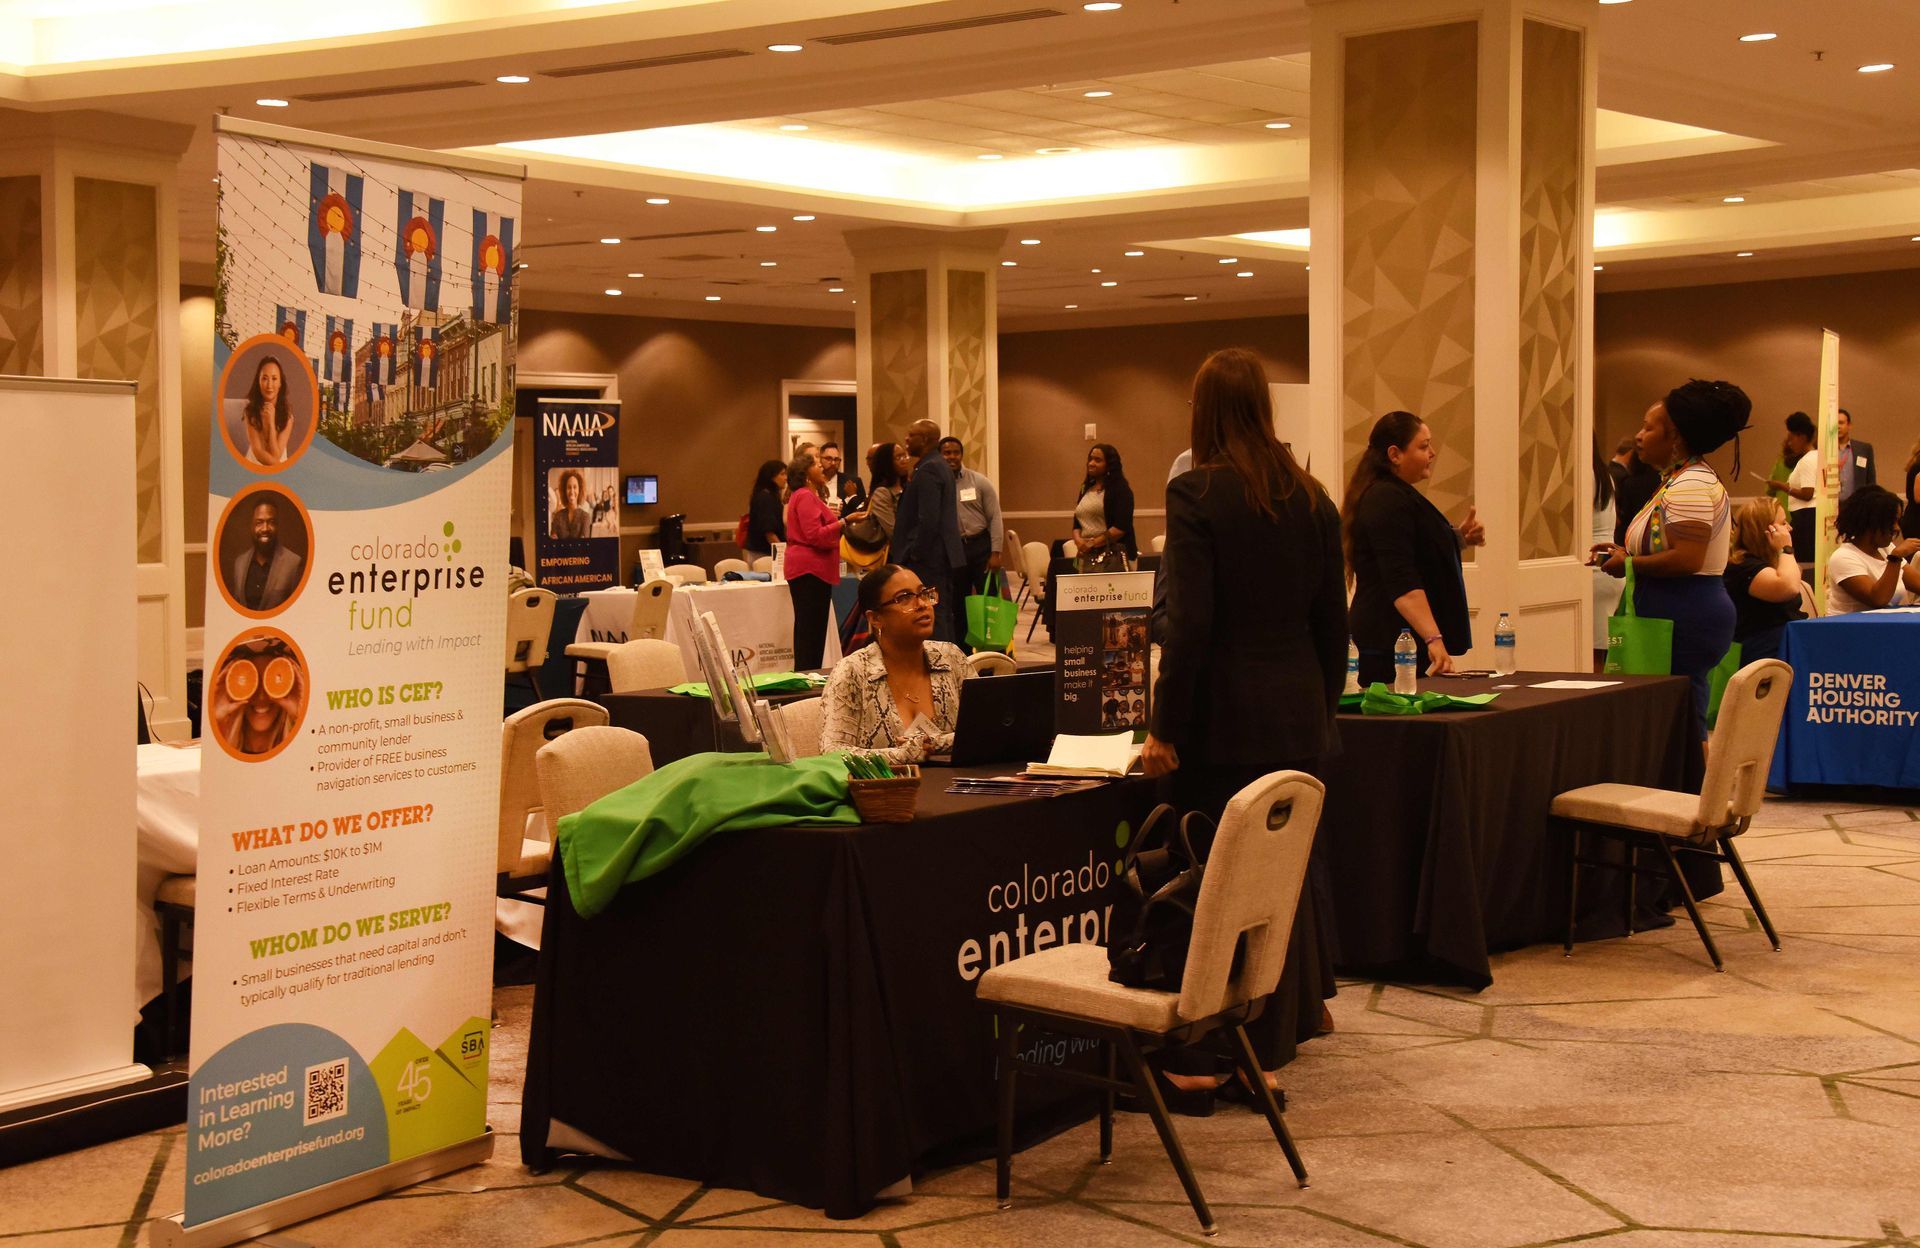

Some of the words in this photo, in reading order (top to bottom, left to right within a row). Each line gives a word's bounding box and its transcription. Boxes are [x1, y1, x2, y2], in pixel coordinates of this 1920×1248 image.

[543, 412, 604, 437] NAAIA
[351, 535, 439, 560] colorado
[540, 556, 590, 567] EMPOWERING
[328, 563, 485, 598] enterprise
[541, 575, 574, 585] AFRICAN
[574, 574, 613, 584] AMERICAN
[1064, 585, 1098, 594] colorado
[1074, 593, 1123, 603] enterprise
[1124, 591, 1148, 601] fund
[349, 598, 413, 631] fund
[348, 639, 402, 656] Lending
[406, 635, 434, 651] with
[437, 634, 482, 650] Impact
[1064, 645, 1094, 655] helping
[1064, 657, 1086, 666] small
[1064, 669, 1097, 678] business
[1064, 681, 1087, 689] make
[1088, 680, 1093, 688] it
[1809, 672, 1887, 690] DENVER
[326, 687, 373, 710] WHO
[378, 685, 395, 705] IS
[400, 681, 443, 703] CEF?
[1808, 688, 1901, 708] HOUSING
[318, 724, 326, 736] A
[328, 719, 383, 734] non-profit,
[384, 715, 411, 729] small
[413, 711, 456, 725] business
[457, 710, 464, 721] &
[1806, 706, 1919, 727] AUTHORITY
[317, 737, 378, 755] community
[380, 733, 413, 747] lender
[317, 758, 360, 773] Provider
[363, 754, 374, 766] of
[375, 752, 402, 766] FREE
[404, 748, 447, 762] business
[316, 774, 375, 792] navigation
[373, 770, 413, 784] services
[414, 768, 425, 778] to
[427, 761, 477, 776] customers
[232, 824, 295, 852] WHAT
[300, 819, 328, 842] DO
[332, 814, 362, 837] WE
[367, 803, 434, 831] OFFER?
[238, 862, 267, 876] Loan
[269, 853, 320, 871] Amounts:
[323, 847, 348, 863] $10K
[350, 846, 361, 857] to
[363, 841, 382, 856] $1M
[236, 894, 280, 914] Flexible
[282, 890, 316, 905] Terms
[318, 887, 326, 899] &
[328, 875, 397, 897] Underwriting
[237, 879, 268, 895] Fixed
[271, 872, 313, 887] Interest
[315, 867, 340, 880] Rate
[988, 849, 1110, 913] colorado
[249, 928, 318, 960] WHOM
[322, 922, 351, 945] DO
[356, 915, 385, 938] WE
[389, 902, 452, 932] SERVE?
[957, 904, 1114, 981] enterpr
[241, 969, 273, 987] Small
[275, 958, 333, 979] businesses
[335, 953, 357, 966] that
[359, 945, 385, 961] need
[387, 938, 420, 959] capital
[422, 932, 441, 947] and
[240, 984, 287, 1007] typically
[289, 976, 325, 996] qualify
[327, 972, 343, 985] for
[343, 961, 395, 983] traditional
[397, 953, 435, 971] lending
[461, 1037, 485, 1054] SBA
[200, 1065, 288, 1105] Interested
[397, 1060, 432, 1102] 45
[199, 1110, 215, 1129] in
[220, 1090, 295, 1123] Learning
[198, 1122, 252, 1152] More?
[194, 1126, 365, 1186] coloradoenterprisefund.org
